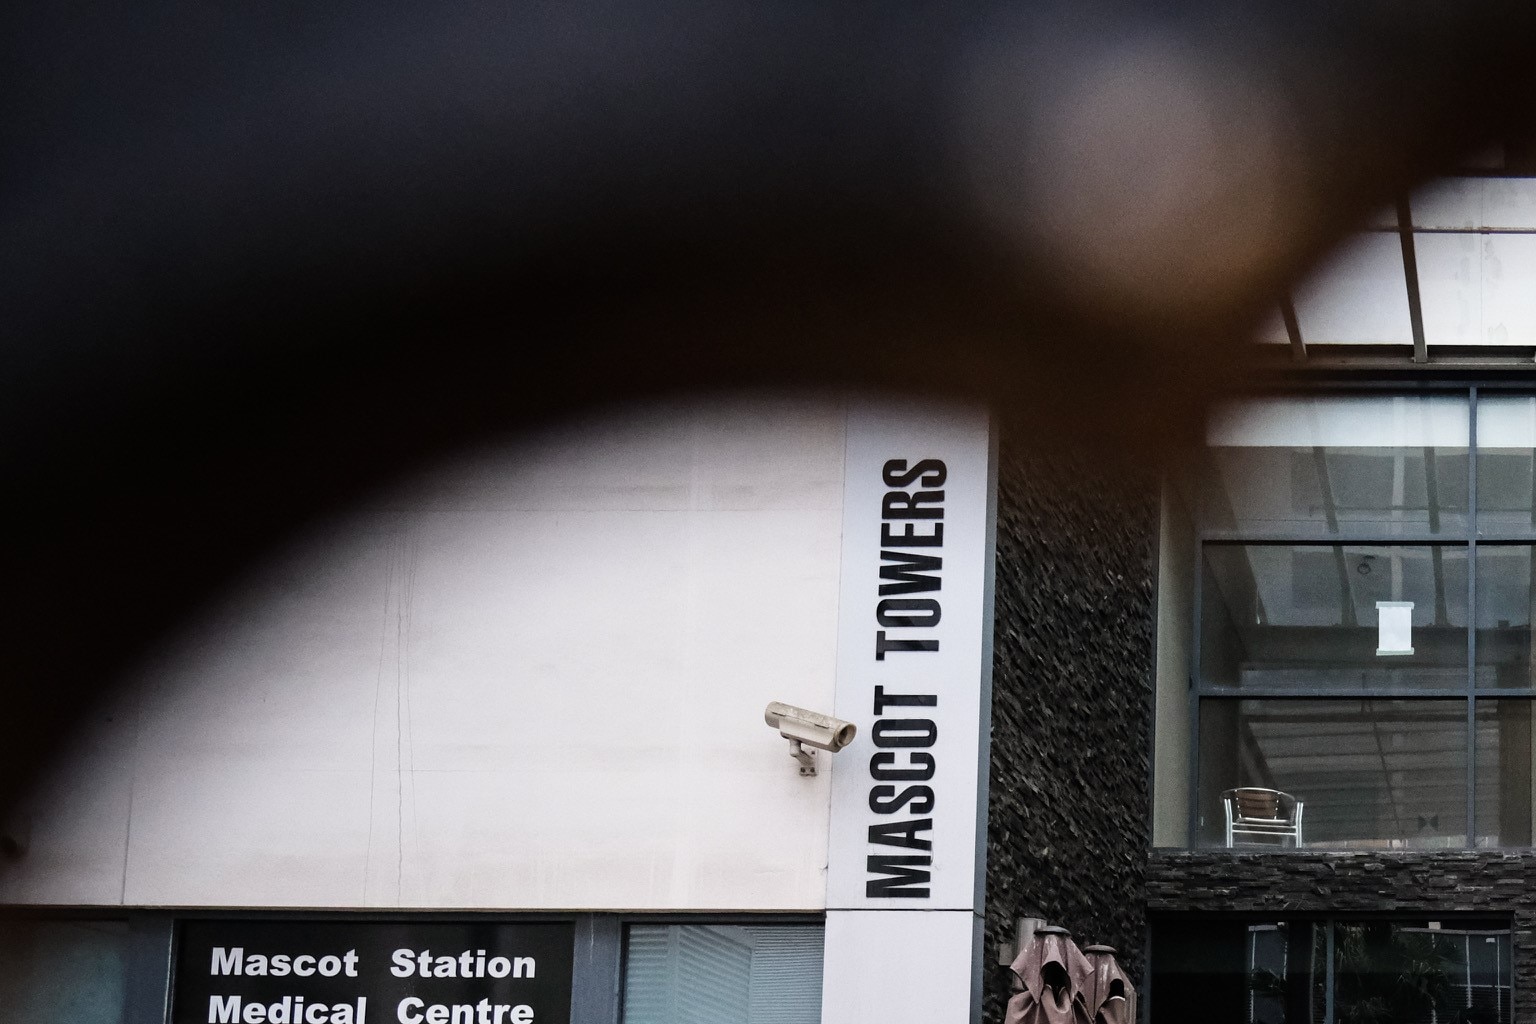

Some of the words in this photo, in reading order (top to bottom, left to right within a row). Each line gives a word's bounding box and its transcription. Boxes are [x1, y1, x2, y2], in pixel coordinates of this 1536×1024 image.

[875, 458, 948, 661] TOWERS
[866, 685, 938, 899] MASCOT
[210, 947, 359, 978] Mascot
[390, 948, 536, 979] Station
